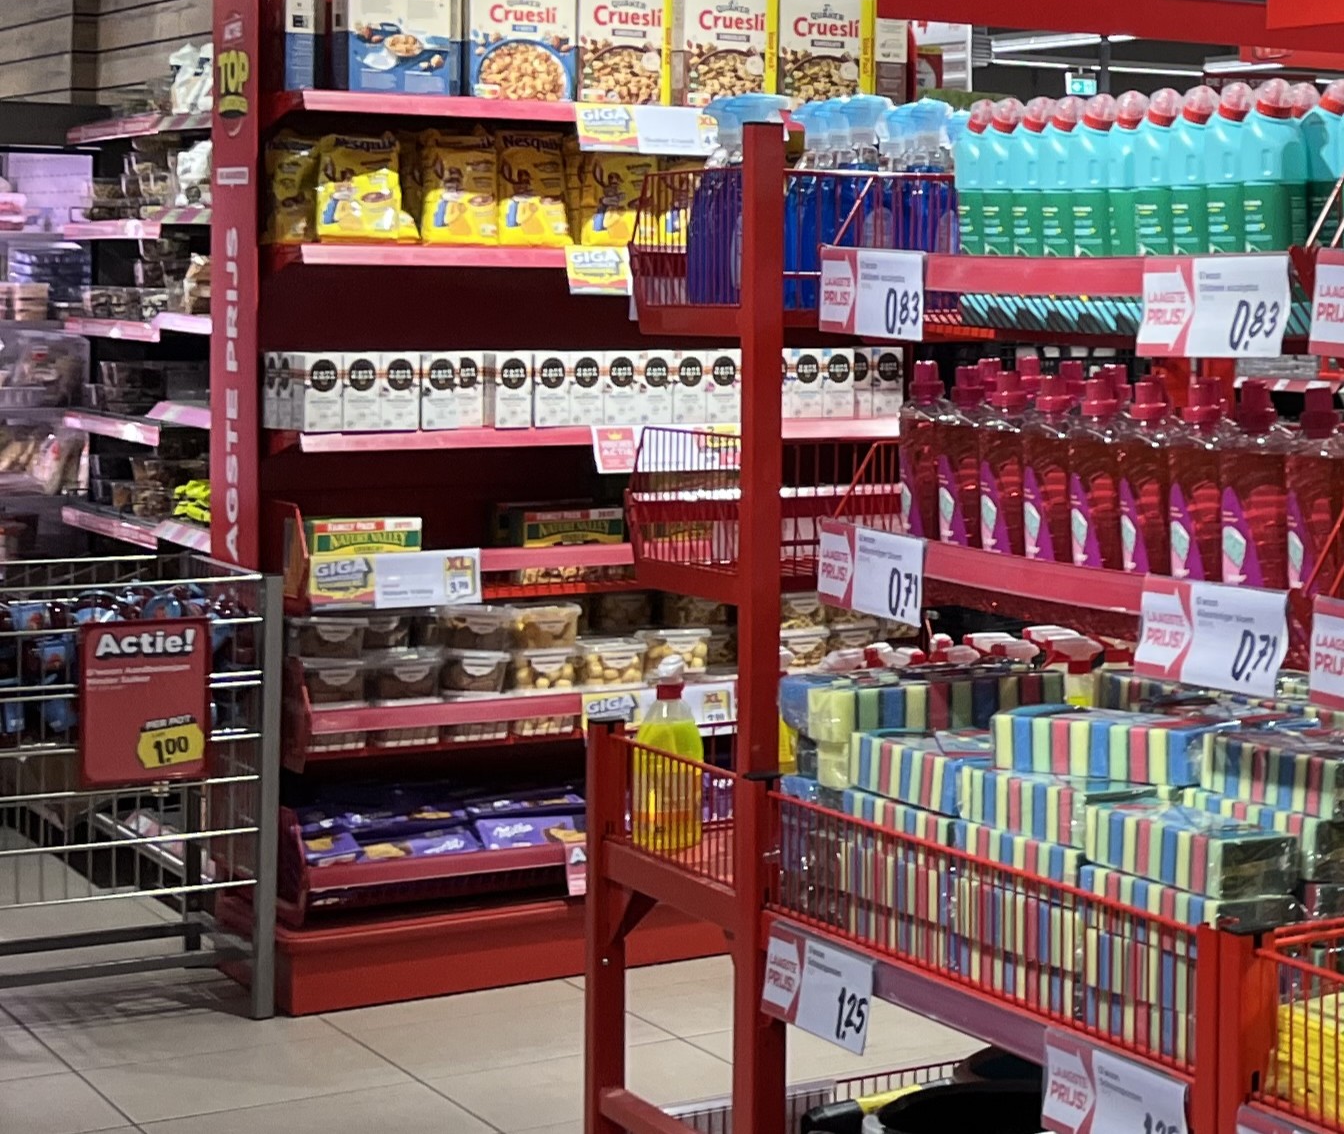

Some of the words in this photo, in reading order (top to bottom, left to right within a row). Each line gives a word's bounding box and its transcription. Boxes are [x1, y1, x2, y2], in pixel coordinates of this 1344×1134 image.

[489, 3, 557, 25] Cruesli
[593, 4, 663, 27] Cruesli
[698, 9, 767, 32] Cruesli
[793, 16, 861, 39] Cruesli
[217, 49, 250, 93] TOP
[582, 107, 630, 121] GIGA
[571, 248, 620, 263] GIGA
[226, 227, 240, 373] PRIJS
[823, 290, 851, 305] PRIJS!
[1147, 291, 1187, 305] LAAGSTE
[885, 287, 920, 335] 0.83
[1146, 306, 1184, 326] PRIJS!
[1229, 299, 1280, 352] 0.83
[225, 387, 240, 563] AGSTE
[315, 558, 370, 577] GIGA
[888, 566, 919, 617] 0.71
[1145, 609, 1185, 629] LAAGSTE
[95, 628, 196, 657] Actie!
[1145, 628, 1185, 650] PRIJS!
[1231, 629, 1277, 683] 0.71
[585, 693, 638, 715] GIGA
[152, 735, 190, 764] 1.00
[835, 986, 869, 1041] 1.25
